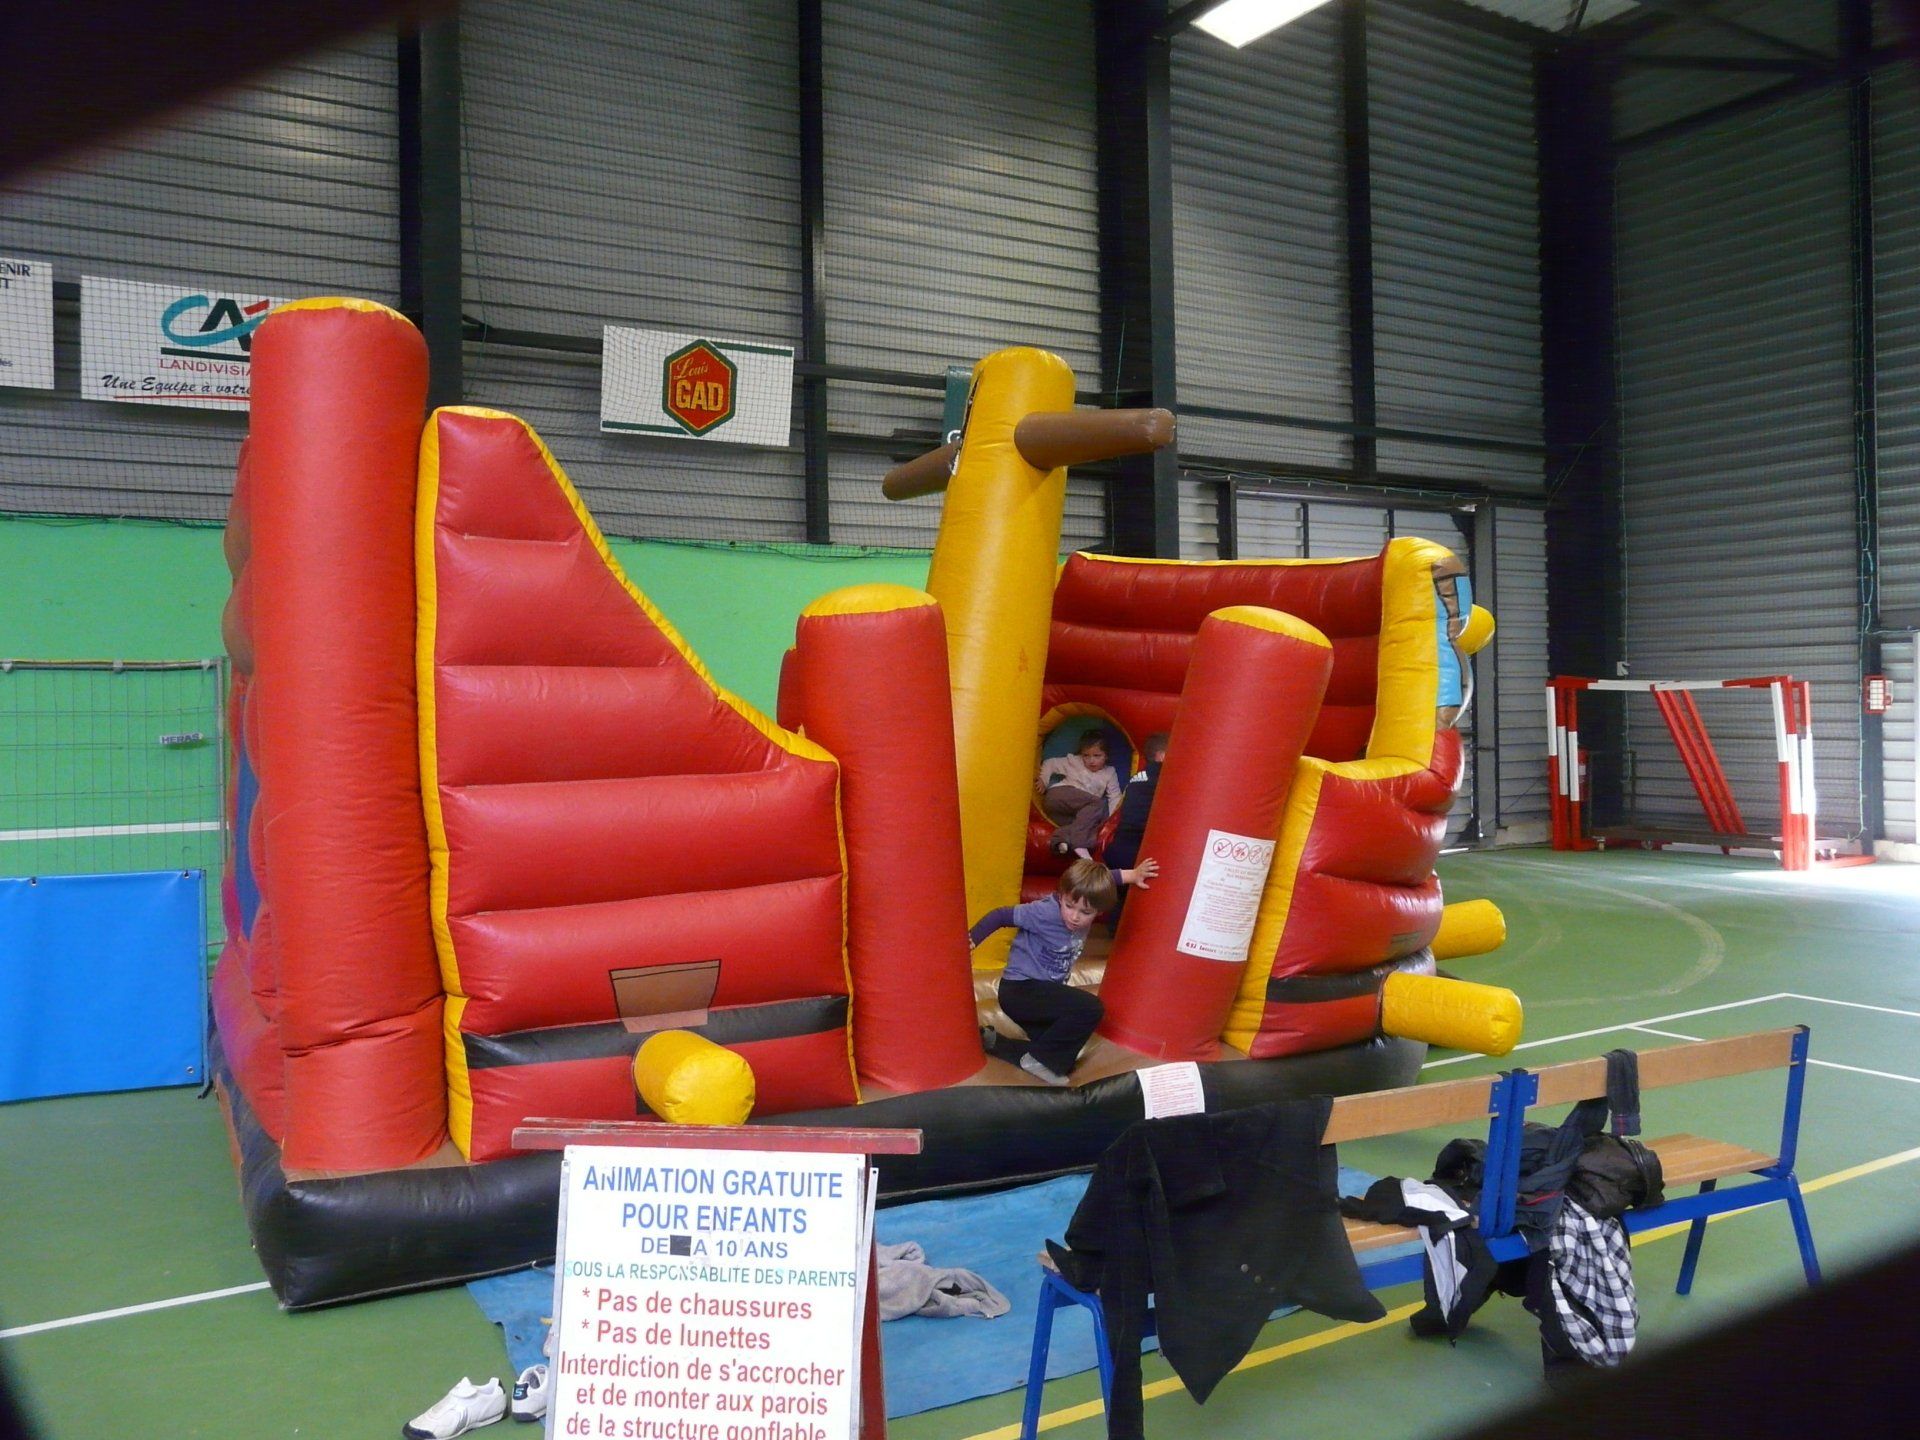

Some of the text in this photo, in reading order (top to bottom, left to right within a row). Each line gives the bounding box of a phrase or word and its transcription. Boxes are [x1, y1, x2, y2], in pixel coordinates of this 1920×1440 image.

[102, 374, 136, 390] Une
[142, 377, 196, 394] Equipe
[202, 382, 211, 393] à
[674, 358, 709, 380] Louis
[676, 380, 724, 411] GAD
[583, 1165, 843, 1198] ANIMATION GRATUITE
[622, 1203, 807, 1234] POUR ENFANTS
[641, 1237, 788, 1259] DE A 10 ANS
[607, 1263, 625, 1279] LA
[755, 1268, 783, 1285] DES
[788, 1270, 857, 1288] PARENTS
[598, 1288, 812, 1320] Pas de chaussures
[597, 1320, 770, 1349] Pas de lunettes
[561, 1351, 845, 1386] Interdiction de s'accrocher
[576, 1382, 828, 1419] et de monter aux parois
[566, 1412, 826, 1440] de la structure gonflable
